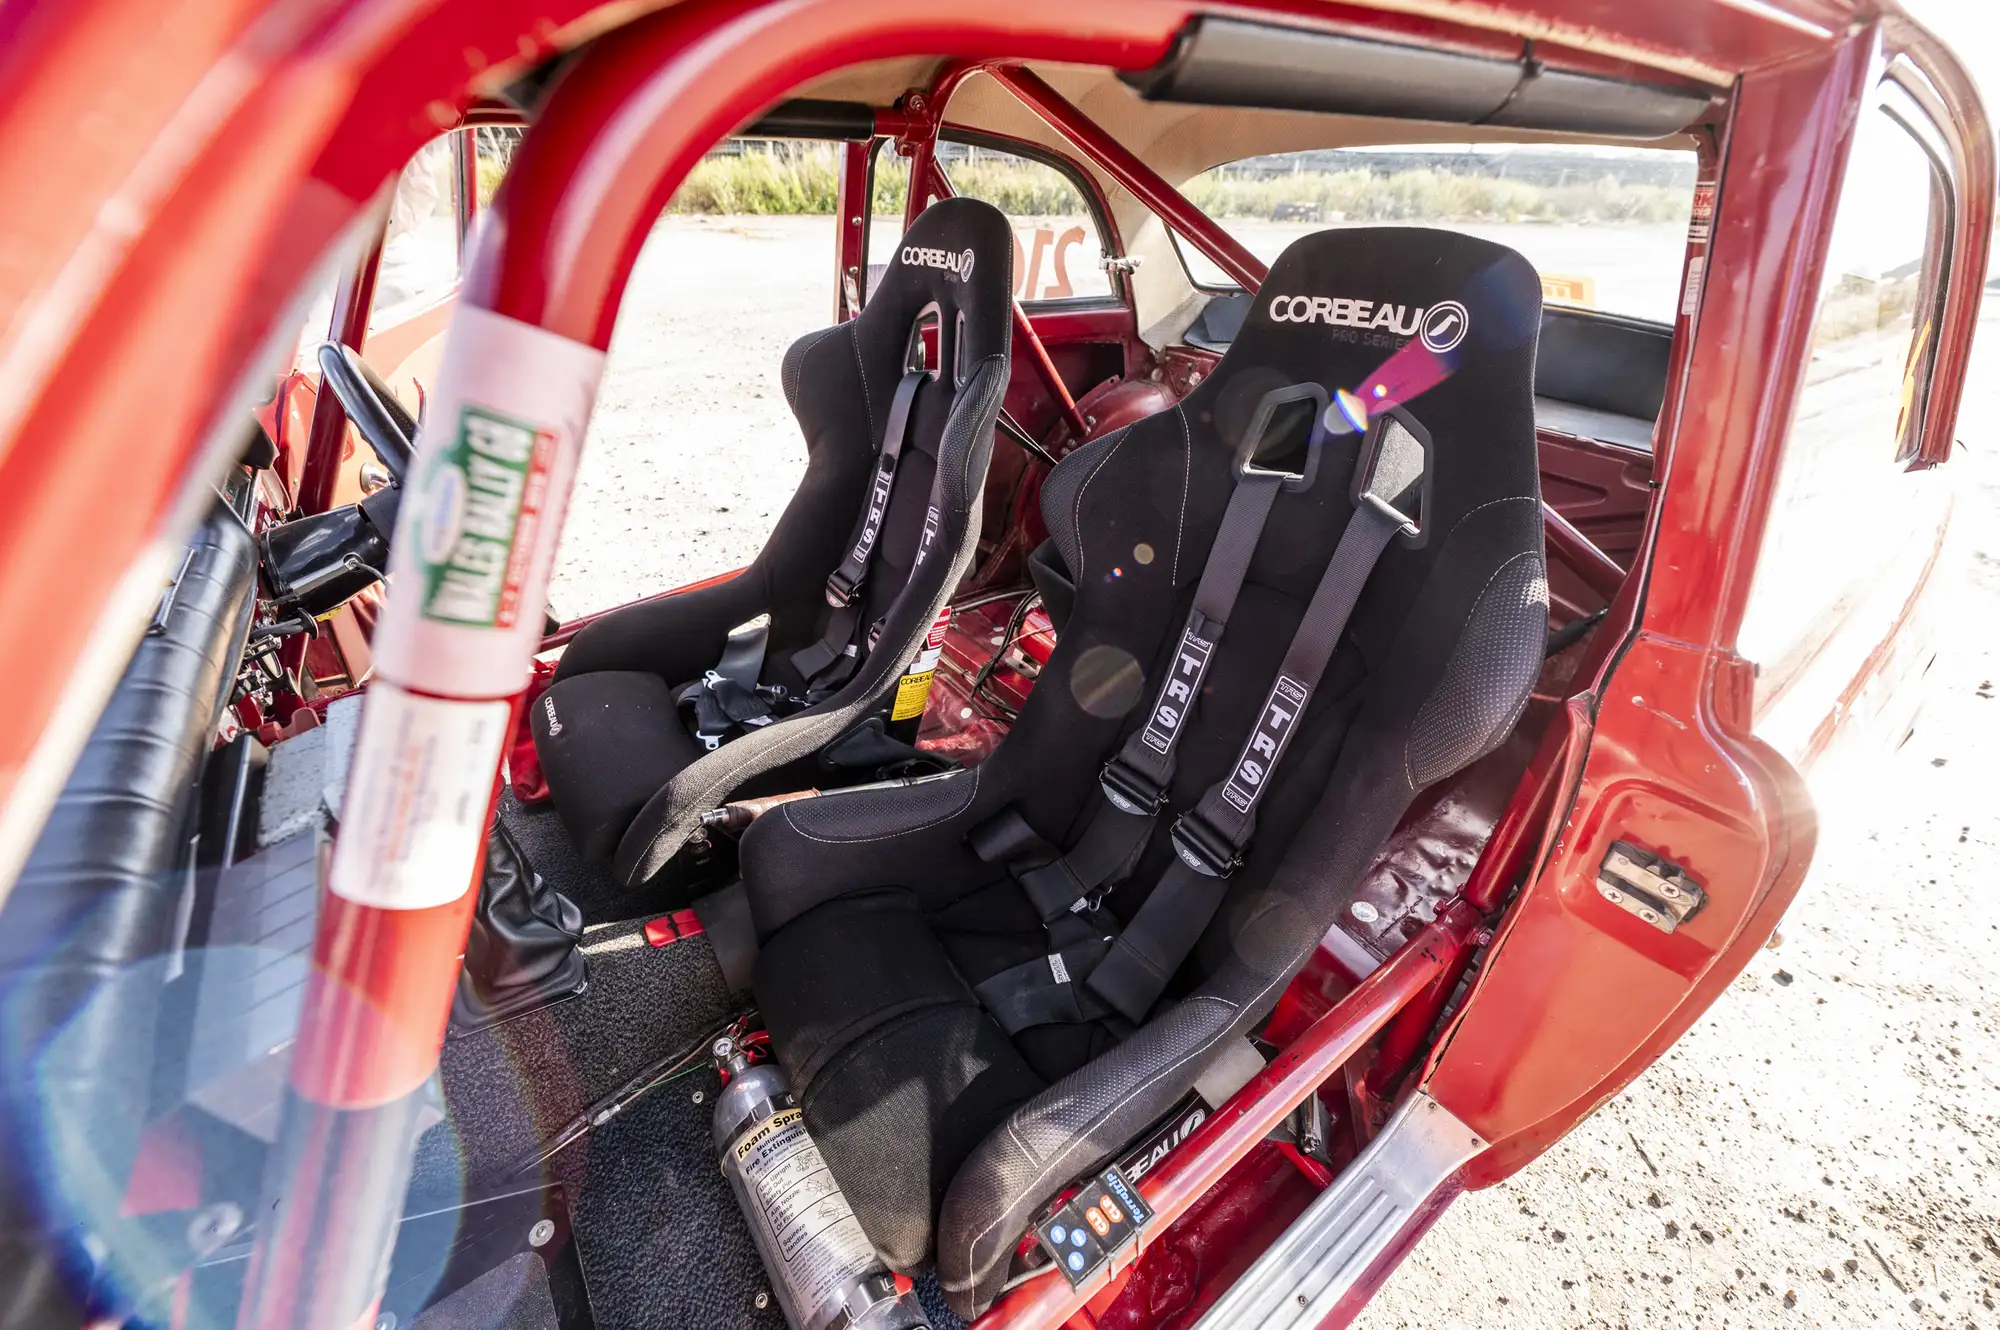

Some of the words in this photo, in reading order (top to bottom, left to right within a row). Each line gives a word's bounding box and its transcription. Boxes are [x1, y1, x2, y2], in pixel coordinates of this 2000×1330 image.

[902, 246, 961, 272] CORBEAU
[1269, 295, 1424, 336] CORBEAU
[863, 487, 886, 543] TRS
[1156, 652, 1201, 729] TRS
[1280, 681, 1303, 701] TRS
[1239, 703, 1291, 785] TRS
[1183, 849, 1200, 867] TRS
[737, 1126, 771, 1158] Foam
[773, 1111, 803, 1128] Spra
[756, 1124, 798, 1152] Multipurpose
[745, 1158, 760, 1175] Fire
[760, 1181, 769, 1192] Use
[770, 1163, 792, 1182] Upright
[762, 1188, 773, 1199] Pull
[773, 1177, 784, 1188] Out
[765, 1189, 782, 1206] Safety
[782, 1179, 793, 1191] Pin
[1106, 1173, 1145, 1224] Terratrip
[770, 1204, 781, 1217] Aim
[781, 1189, 801, 1206] Nozzle
[778, 1203, 793, 1218] Base
[1102, 1195, 1121, 1220] CLR
[783, 1212, 795, 1224] Fire
[1088, 1208, 1107, 1233] CLR
[782, 1223, 806, 1247] Squeeze
[785, 1231, 808, 1254] Handles
